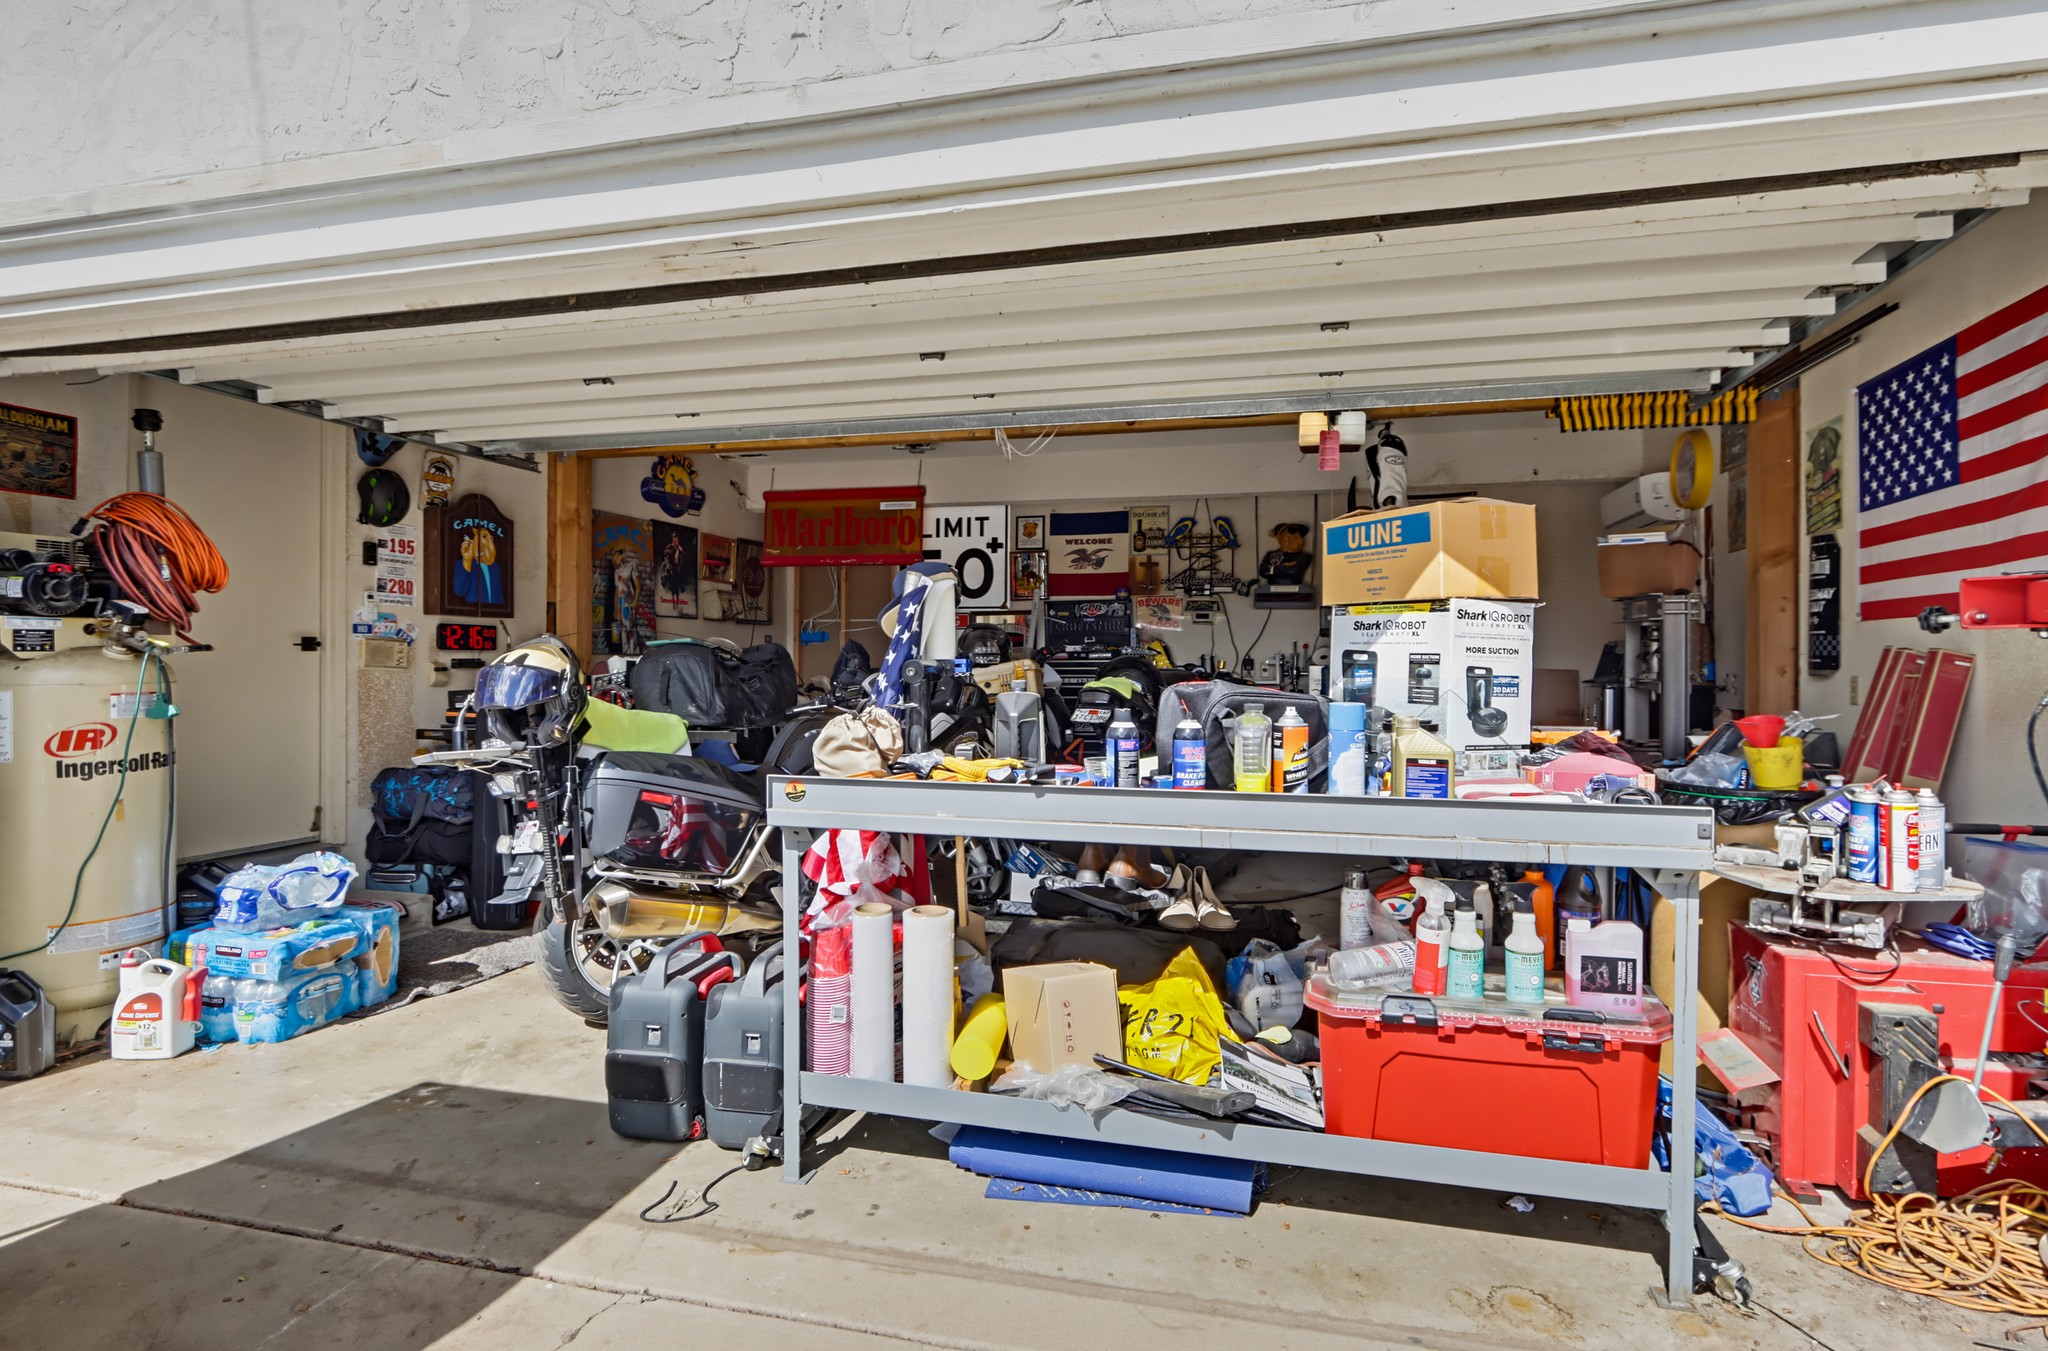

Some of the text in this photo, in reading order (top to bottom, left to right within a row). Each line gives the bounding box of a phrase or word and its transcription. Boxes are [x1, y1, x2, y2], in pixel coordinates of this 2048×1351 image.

[453, 518, 504, 538] CAMEL
[771, 507, 916, 547] Marlboro
[1348, 520, 1402, 549] ULINE
[390, 538, 415, 555] 195
[594, 525, 650, 553] CAMEL
[1065, 538, 1113, 546] WELCOME
[388, 578, 413, 595] 280
[1137, 597, 1182, 608] BEWARE
[1456, 608, 1531, 623] Shark IQ ROBOT
[1154, 620, 1180, 629] DOG
[1353, 619, 1427, 631] Shark IQ ROBOT
[443, 625, 483, 649] 12:16
[1488, 647, 1519, 655] SUCTION
[56, 728, 106, 752] IR
[1919, 833, 1939, 851] EAN
[217, 946, 242, 954] KIRKLAND
